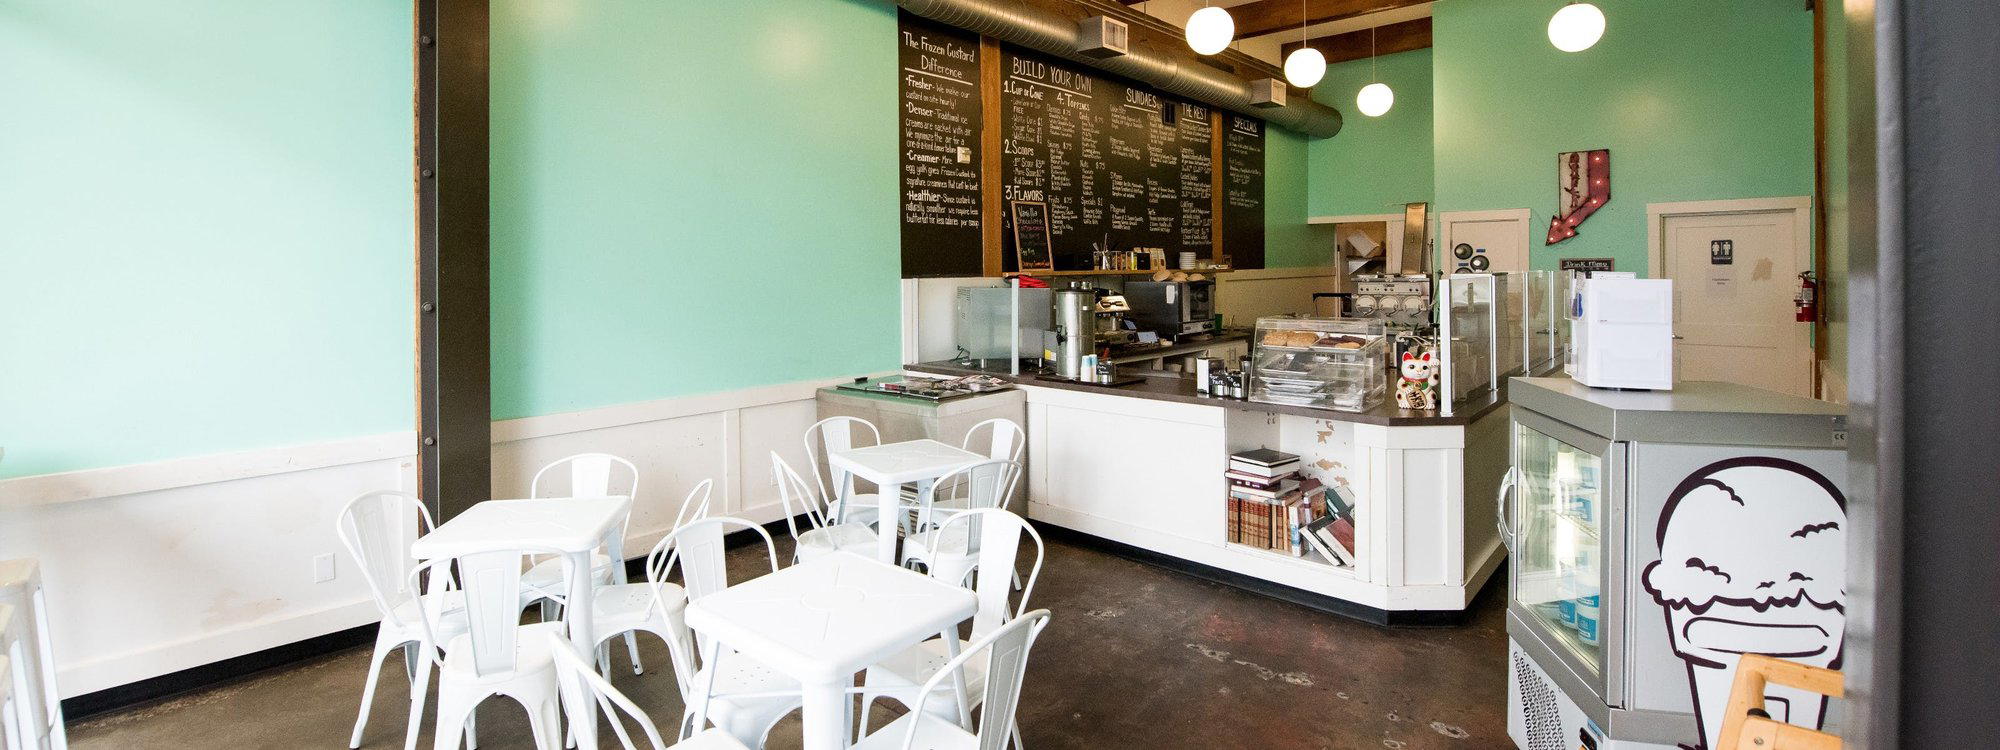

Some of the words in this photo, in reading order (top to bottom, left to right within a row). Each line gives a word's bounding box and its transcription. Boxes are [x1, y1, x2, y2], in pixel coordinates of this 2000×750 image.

[903, 31, 919, 50] The
[921, 36, 946, 56] Frozen
[946, 43, 975, 63] Custard
[921, 54, 963, 79] Difference
[1013, 56, 1046, 80] BUILD
[1050, 66, 1072, 88] YOUR
[1075, 73, 1092, 93] OWN
[1125, 87, 1157, 108] SUNDAES
[1181, 102, 1193, 118] THE
[1193, 105, 1208, 121] REST
[1234, 116, 1258, 133] SPECIALS
